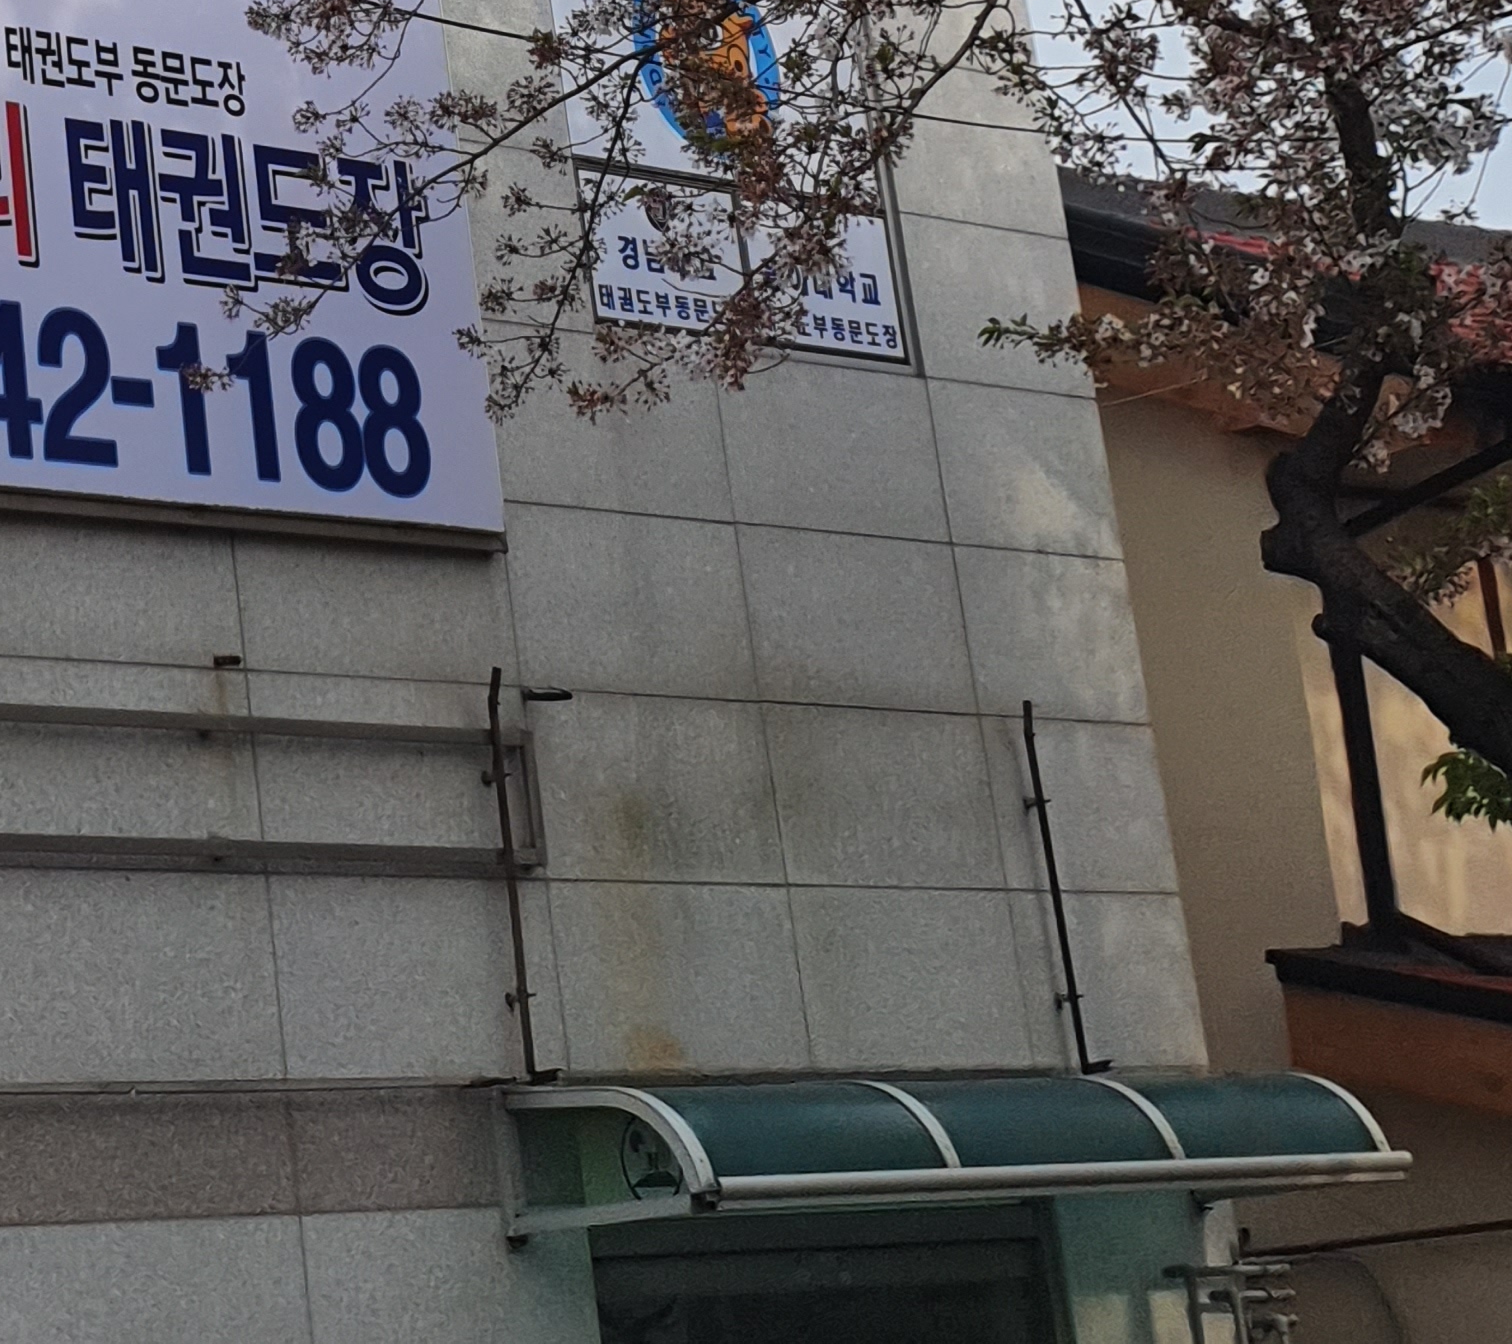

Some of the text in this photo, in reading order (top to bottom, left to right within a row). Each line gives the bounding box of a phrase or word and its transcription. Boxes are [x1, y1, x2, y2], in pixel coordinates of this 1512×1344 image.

[4, 26, 124, 97] 태권도부
[131, 45, 246, 117] 동문도장
[64, 116, 430, 316] 태권도장
